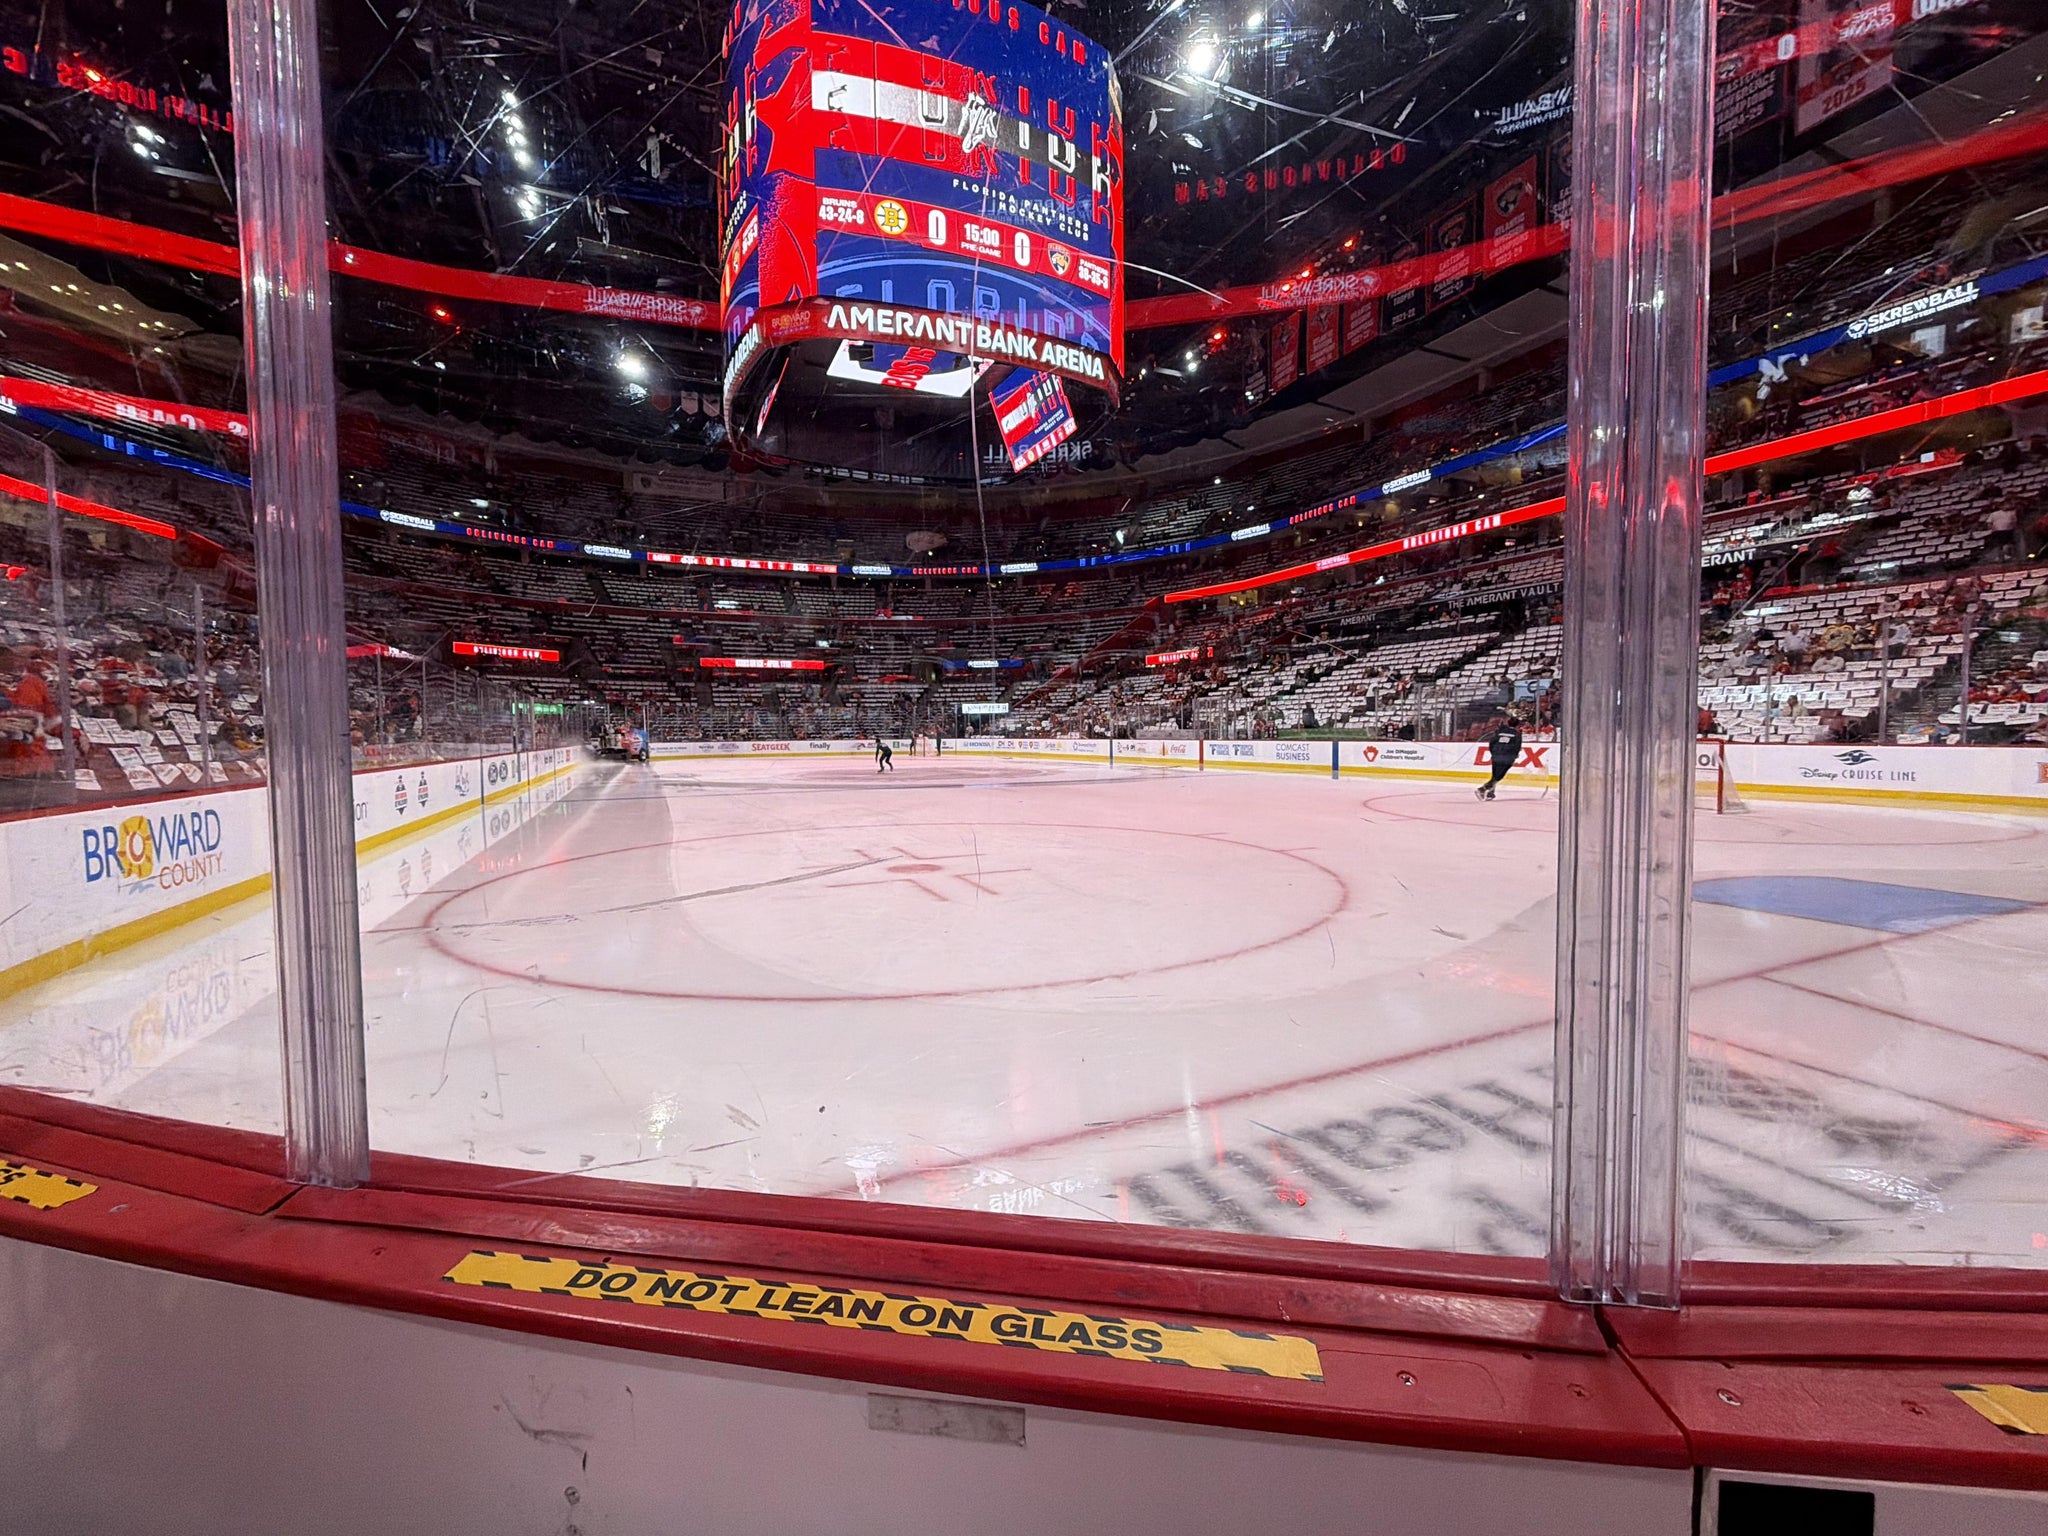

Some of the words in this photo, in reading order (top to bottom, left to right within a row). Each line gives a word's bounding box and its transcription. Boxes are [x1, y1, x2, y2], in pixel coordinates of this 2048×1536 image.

[1039, 21, 1086, 65] CAM
[818, 204, 865, 225] 43-24-8
[822, 197, 858, 209] BRUINS
[952, 179, 1015, 204] FLORIDA
[1024, 200, 1089, 232] PANTHERS
[928, 209, 951, 246] 0
[999, 202, 1051, 226] HOCKEY
[1059, 222, 1089, 241] CLUB
[963, 222, 1000, 248] 15:00
[1014, 231, 1031, 267] 0
[1868, 282, 1981, 327] SKREWBALL
[827, 304, 972, 345] AMERANT
[976, 324, 1037, 361] BANK
[1041, 342, 1104, 380] ARENA
[1403, 524, 1467, 550] OBLIVIOUS
[1475, 515, 1501, 530] CAM
[1701, 548, 1756, 567] ERANT
[1448, 598, 1465, 609] THE
[1466, 590, 1519, 606] AMERANT
[1520, 583, 1560, 597] VAULT
[1340, 613, 1377, 626] AMERANT
[752, 742, 790, 751] SEATGEEK
[809, 742, 831, 750] finally
[1276, 743, 1310, 752] COMCAST
[1276, 751, 1310, 761] BUSINESS
[1474, 746, 1550, 769] DX
[1799, 767, 1838, 781] Disney
[1842, 769, 1883, 781] CRUISE
[1890, 771, 1917, 782] LINE
[83, 809, 221, 883] BROWARD
[159, 853, 223, 890] COUNTY
[564, 1269, 637, 1292] DO
[645, 1278, 749, 1306] NOT
[755, 1288, 885, 1321] LEAN
[899, 1304, 974, 1332] ON
[990, 1314, 1163, 1353] GLASS
